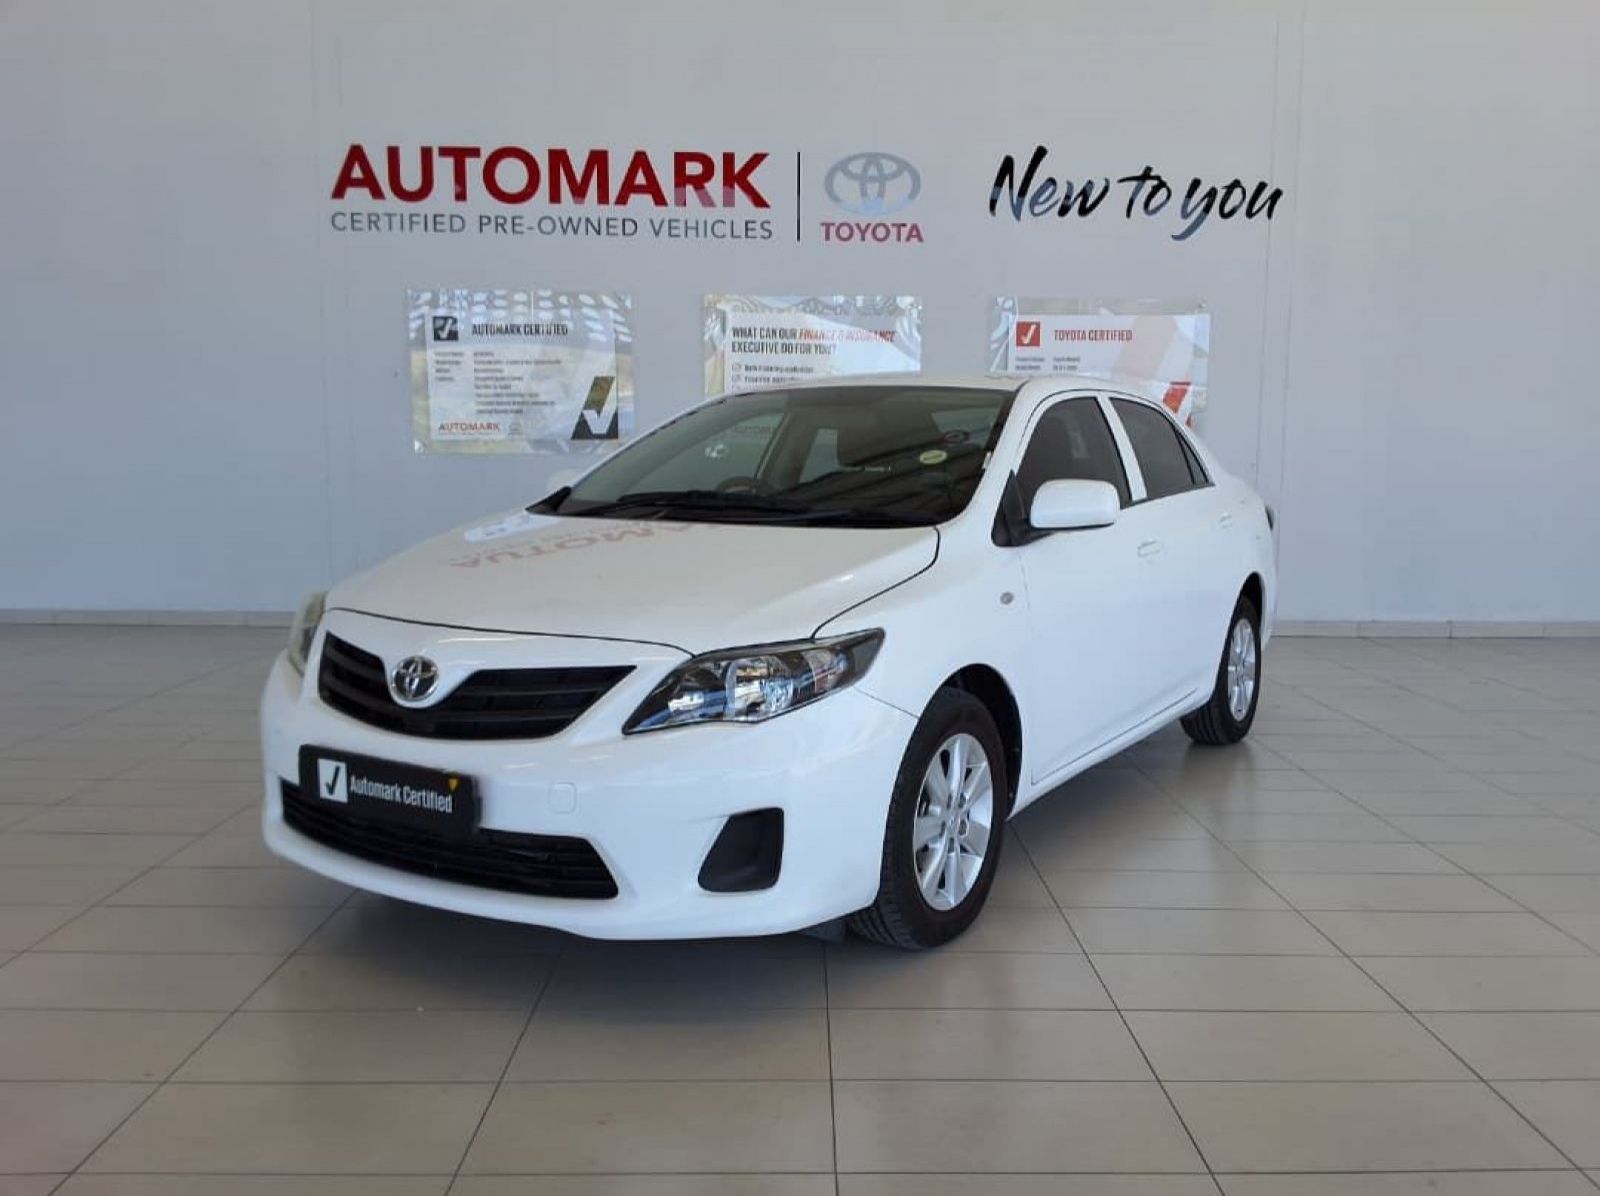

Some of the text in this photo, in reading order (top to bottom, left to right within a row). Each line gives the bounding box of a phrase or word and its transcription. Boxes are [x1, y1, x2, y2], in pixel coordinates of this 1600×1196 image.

[331, 143, 771, 208] AUTOMARK
[989, 145, 1283, 241] New to you
[331, 212, 773, 240] CERTIFIED PRE-OWNED VEHICLES
[821, 222, 924, 243] TOYOTA
[472, 323, 568, 336] AUTOMARK CERTIFIED
[732, 327, 757, 339] WHAT
[759, 328, 777, 340] CAN
[779, 328, 797, 340] OUR
[1054, 329, 1133, 342] TOYOTA CERTIFIED
[731, 341, 779, 354] EXECUTIVE
[781, 342, 792, 354] DO
[794, 342, 812, 355] FOR
[438, 422, 500, 433] AUTOMARK
[350, 776, 452, 813] Automark Certified
